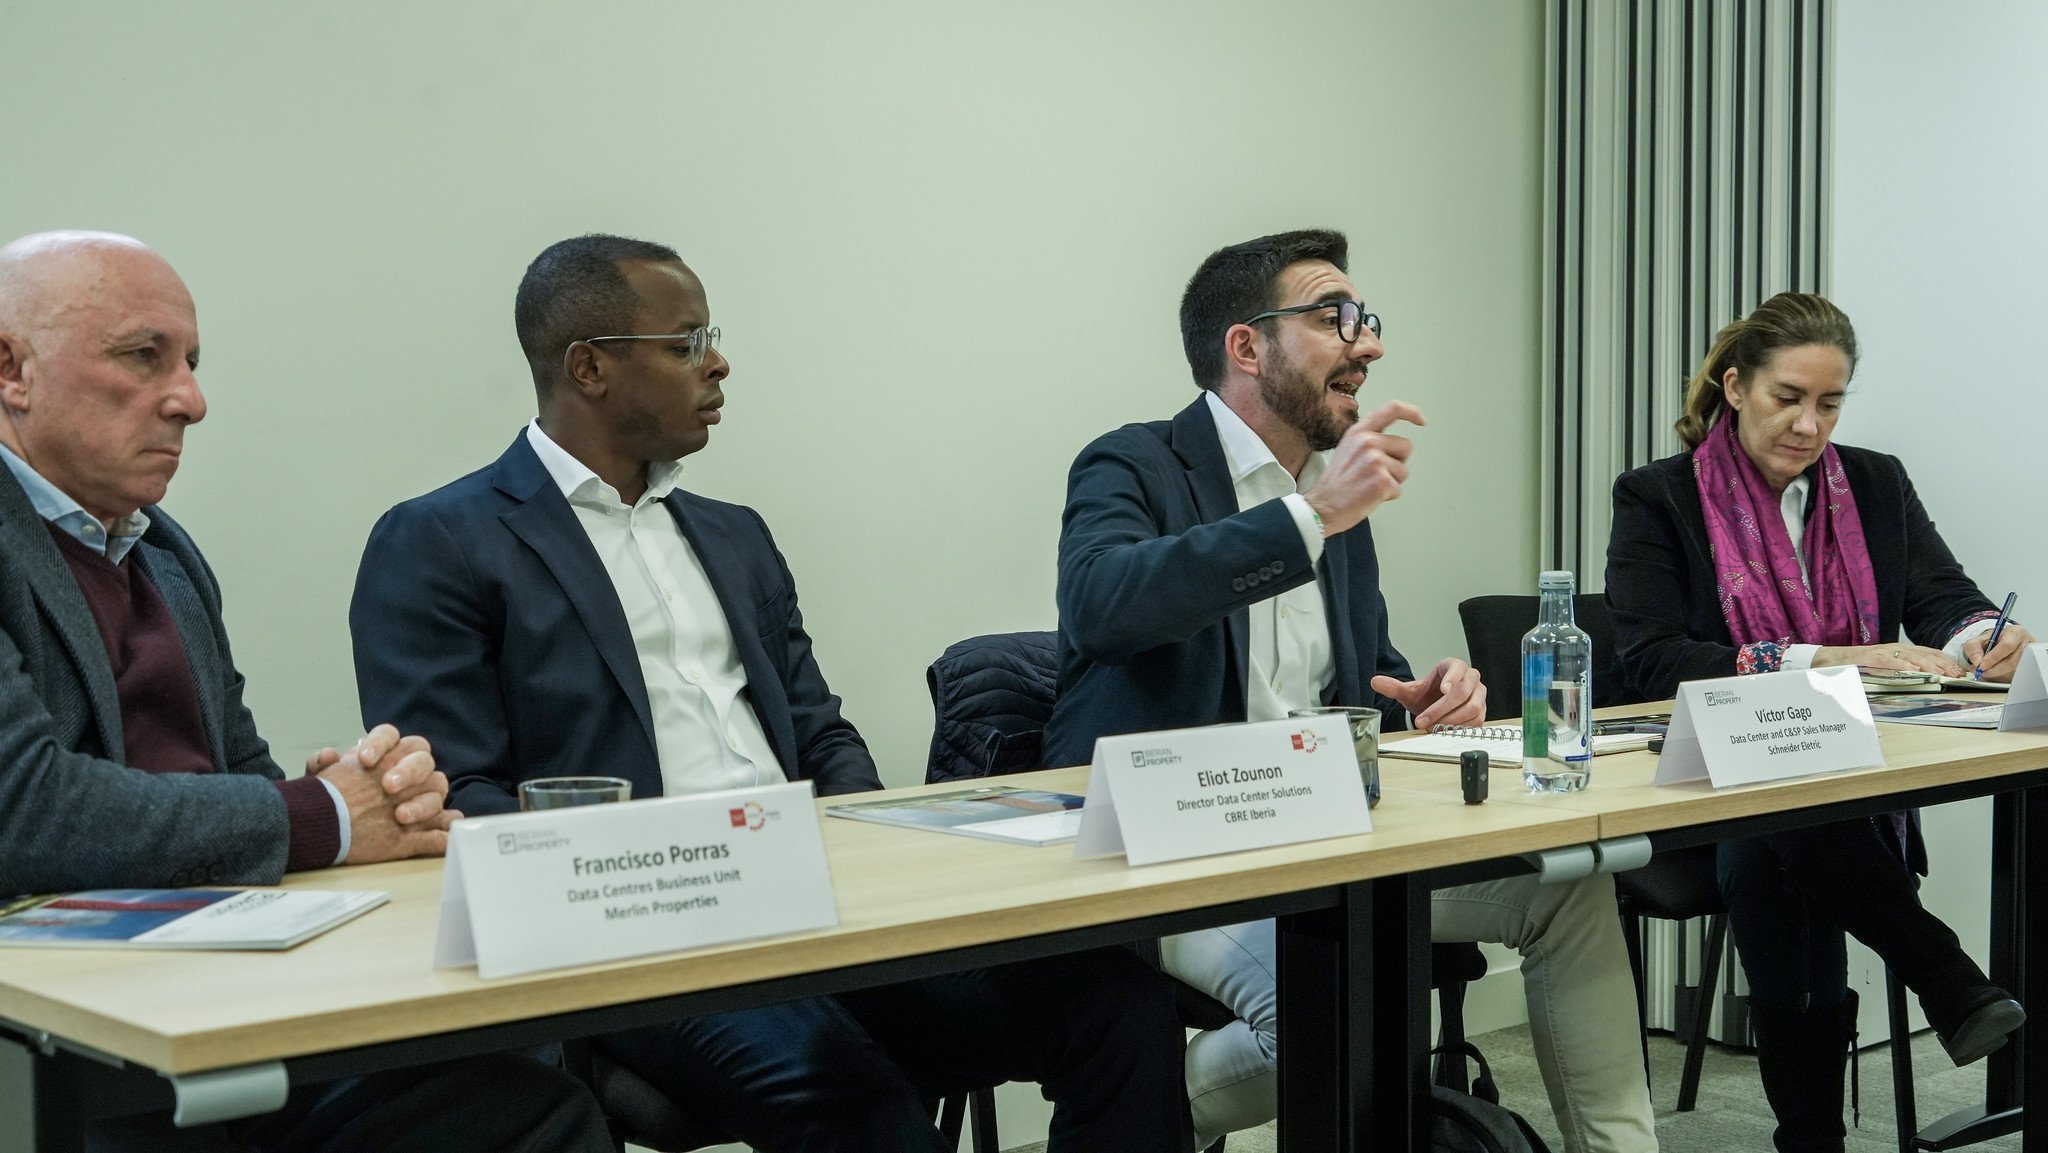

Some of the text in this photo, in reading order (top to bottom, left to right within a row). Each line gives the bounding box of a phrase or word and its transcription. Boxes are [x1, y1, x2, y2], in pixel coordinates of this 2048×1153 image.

[1716, 697, 1741, 705] PROPERTY
[1787, 706, 1812, 721] Gago
[1730, 723, 1847, 744] Data Center and C&SP Sales Manager
[1768, 740, 1821, 755] Schneider Eletric
[1146, 756, 1182, 766] PROPERTY
[1197, 765, 1283, 787] Eliot Zounon
[1177, 785, 1312, 811] Director Data Center Solutions
[1225, 808, 1276, 823] CBRE Iberia
[519, 838, 570, 852] PROPERTY
[573, 842, 730, 876] Francisco Porras
[567, 869, 741, 903] Data Centres Business Unit
[605, 894, 719, 920] Merlin Properties
